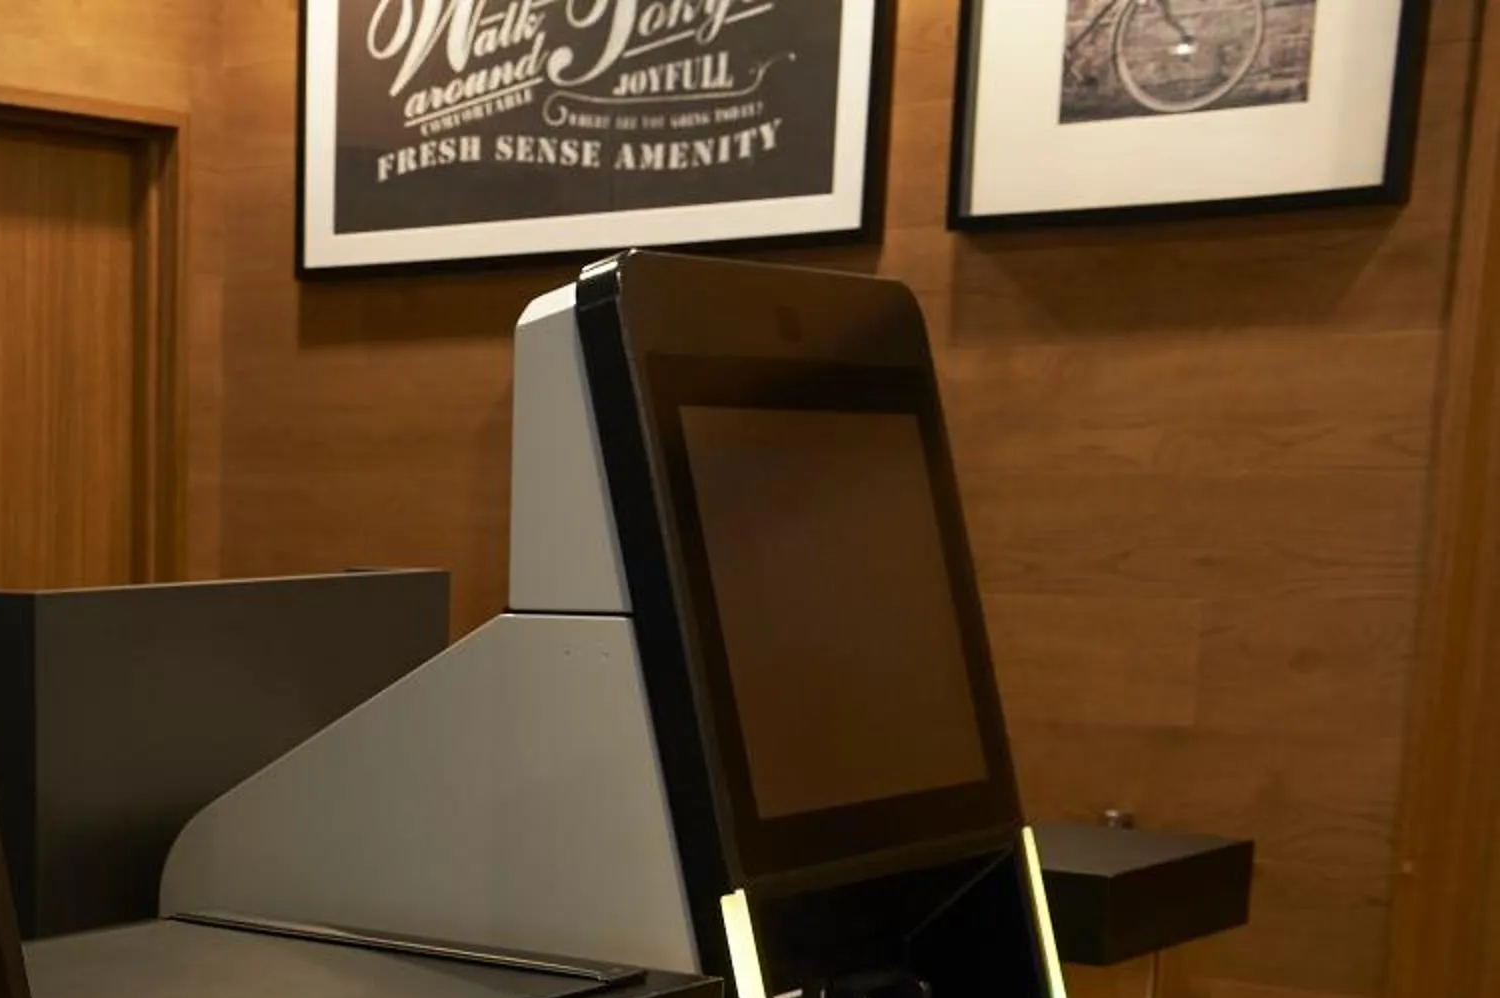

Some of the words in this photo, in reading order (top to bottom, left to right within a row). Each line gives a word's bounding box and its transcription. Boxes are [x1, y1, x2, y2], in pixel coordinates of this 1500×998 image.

[404, 32, 548, 118] around
[612, 51, 734, 96] JOYFULL
[377, 135, 482, 182] FRESH
[494, 135, 602, 168] SENSE
[613, 118, 783, 171] AMENITY
